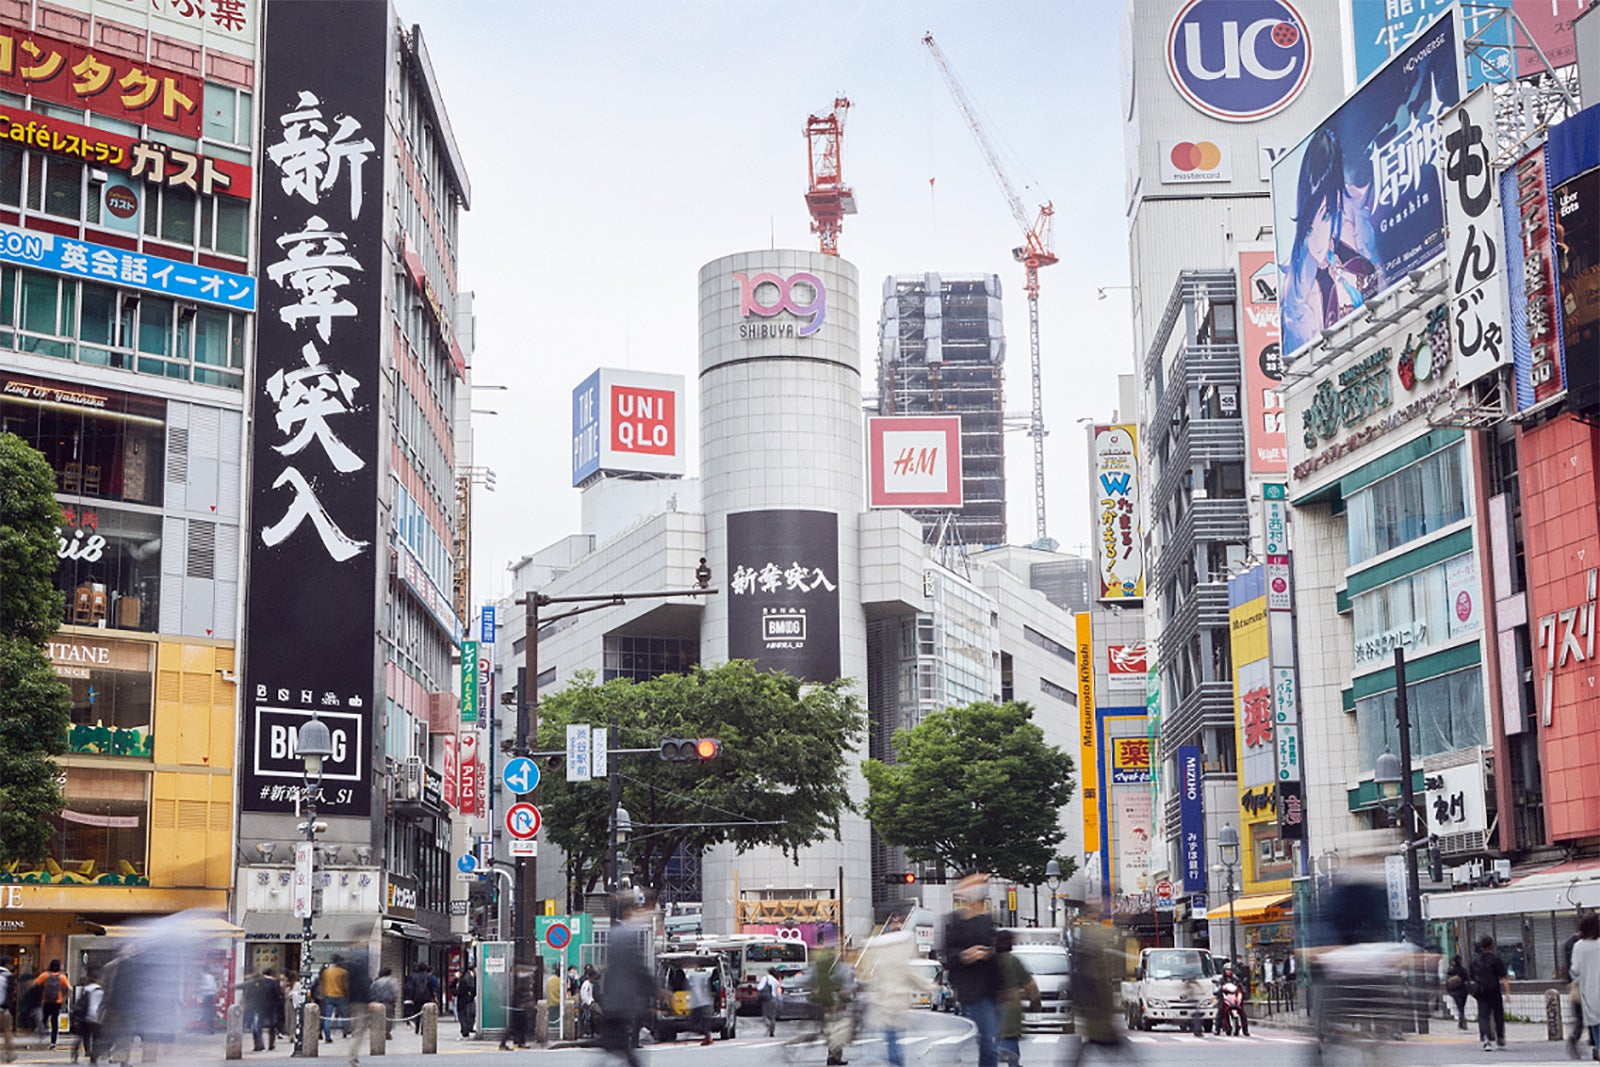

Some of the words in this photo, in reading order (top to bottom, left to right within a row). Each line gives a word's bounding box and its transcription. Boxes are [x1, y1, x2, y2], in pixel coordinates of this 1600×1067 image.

[1184, 19, 1298, 80] UC
[53, 131, 124, 164] レストラン
[131, 142, 231, 195] ガスト
[1173, 172, 1221, 180] mastercard
[109, 198, 135, 211] ガスト
[1380, 193, 1429, 232] Genshin
[1560, 191, 1579, 206] Uber
[1560, 202, 1580, 218] Eats
[1445, 107, 1503, 362] もんじゃ
[60, 241, 250, 301] 英会話イーオン
[1515, 158, 1554, 389] 三千里薬品
[732, 271, 826, 337] 109
[260, 90, 376, 562] 新章突入
[740, 323, 794, 338] SHIBUYA
[618, 393, 664, 421] UNI
[618, 421, 669, 448] QLO
[894, 446, 938, 476] H&M
[730, 560, 837, 595] 新章突入
[1080, 643, 1090, 683] KiYoshi
[1083, 685, 1093, 747] Matsumoto
[1243, 685, 1273, 749] 薬
[270, 724, 347, 763] BMG
[1120, 739, 1150, 766] 薬
[1186, 756, 1196, 800] MIZUHO
[1187, 832, 1199, 880] みずほ銀行
[257, 872, 372, 887] 渋谷前ビル
